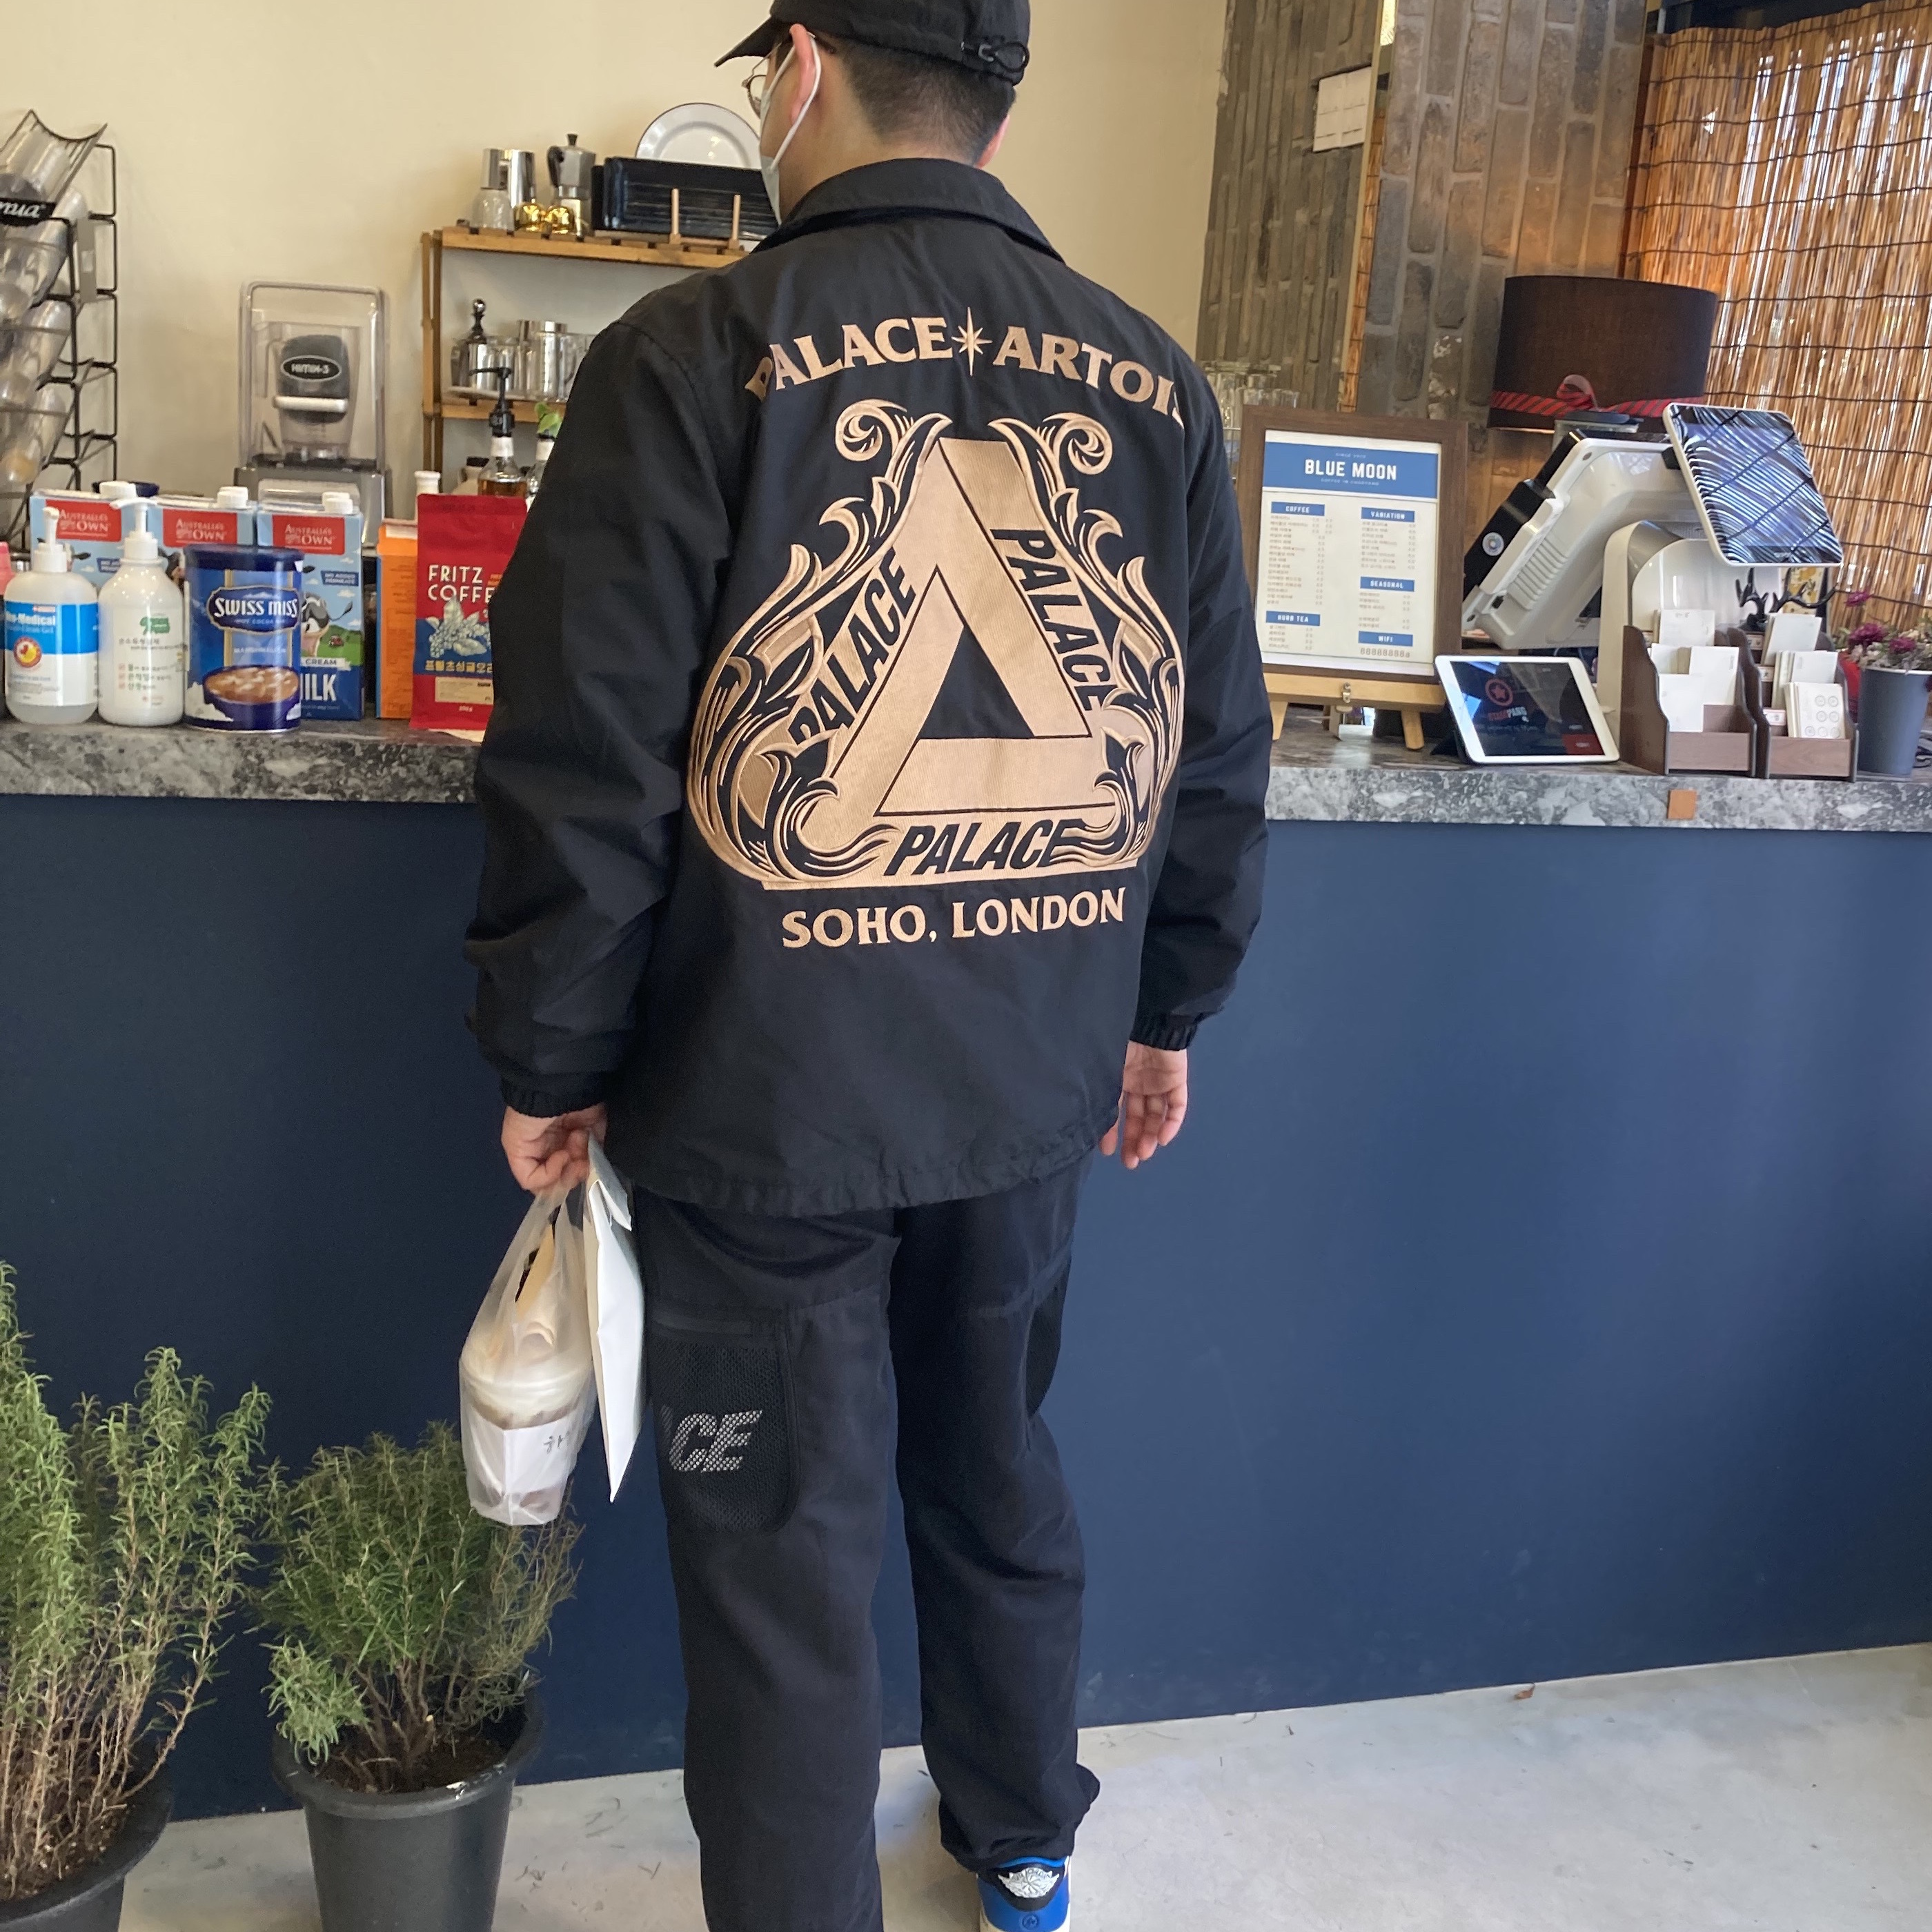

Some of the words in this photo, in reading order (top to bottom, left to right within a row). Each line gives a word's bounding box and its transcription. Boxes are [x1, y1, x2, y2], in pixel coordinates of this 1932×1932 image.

[744, 317, 954, 401] PALACE
[1305, 460, 1346, 477] BLUE
[1352, 462, 1397, 481] MOON
[1370, 511, 1406, 520] VARIATION
[76, 521, 109, 532] OWN
[193, 529, 225, 541] OWN
[302, 535, 333, 546] OWN
[428, 564, 483, 584] FRITZ
[1370, 580, 1403, 589] SEASONAL
[428, 584, 495, 604] COFFE
[990, 529, 1118, 711] PALACE
[788, 546, 916, 746] PALACE
[300, 673, 337, 702] ILK
[884, 818, 1086, 876] PALACE
[782, 904, 937, 949] SOHO,
[952, 885, 1127, 940] LONDON
[660, 1405, 762, 1472] CE
